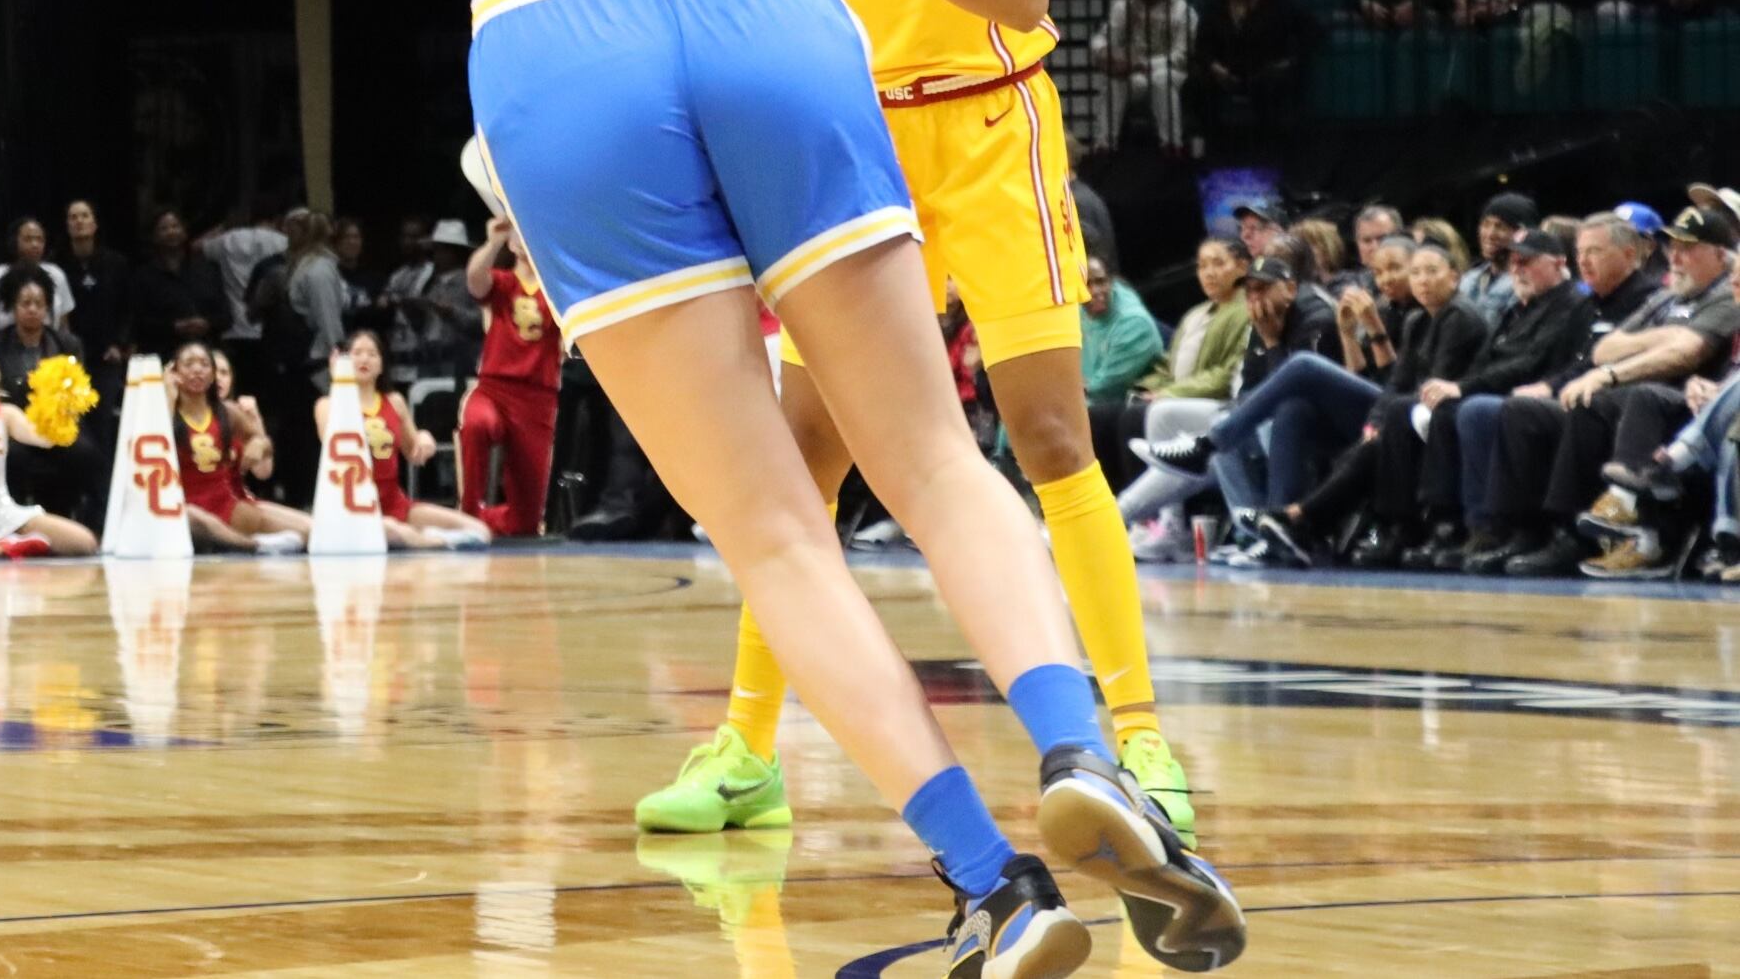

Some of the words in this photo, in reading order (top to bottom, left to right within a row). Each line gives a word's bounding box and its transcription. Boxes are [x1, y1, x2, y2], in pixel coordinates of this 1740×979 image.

[885, 86, 915, 101] USC
[132, 434, 184, 518] SC
[328, 431, 378, 513] SC
